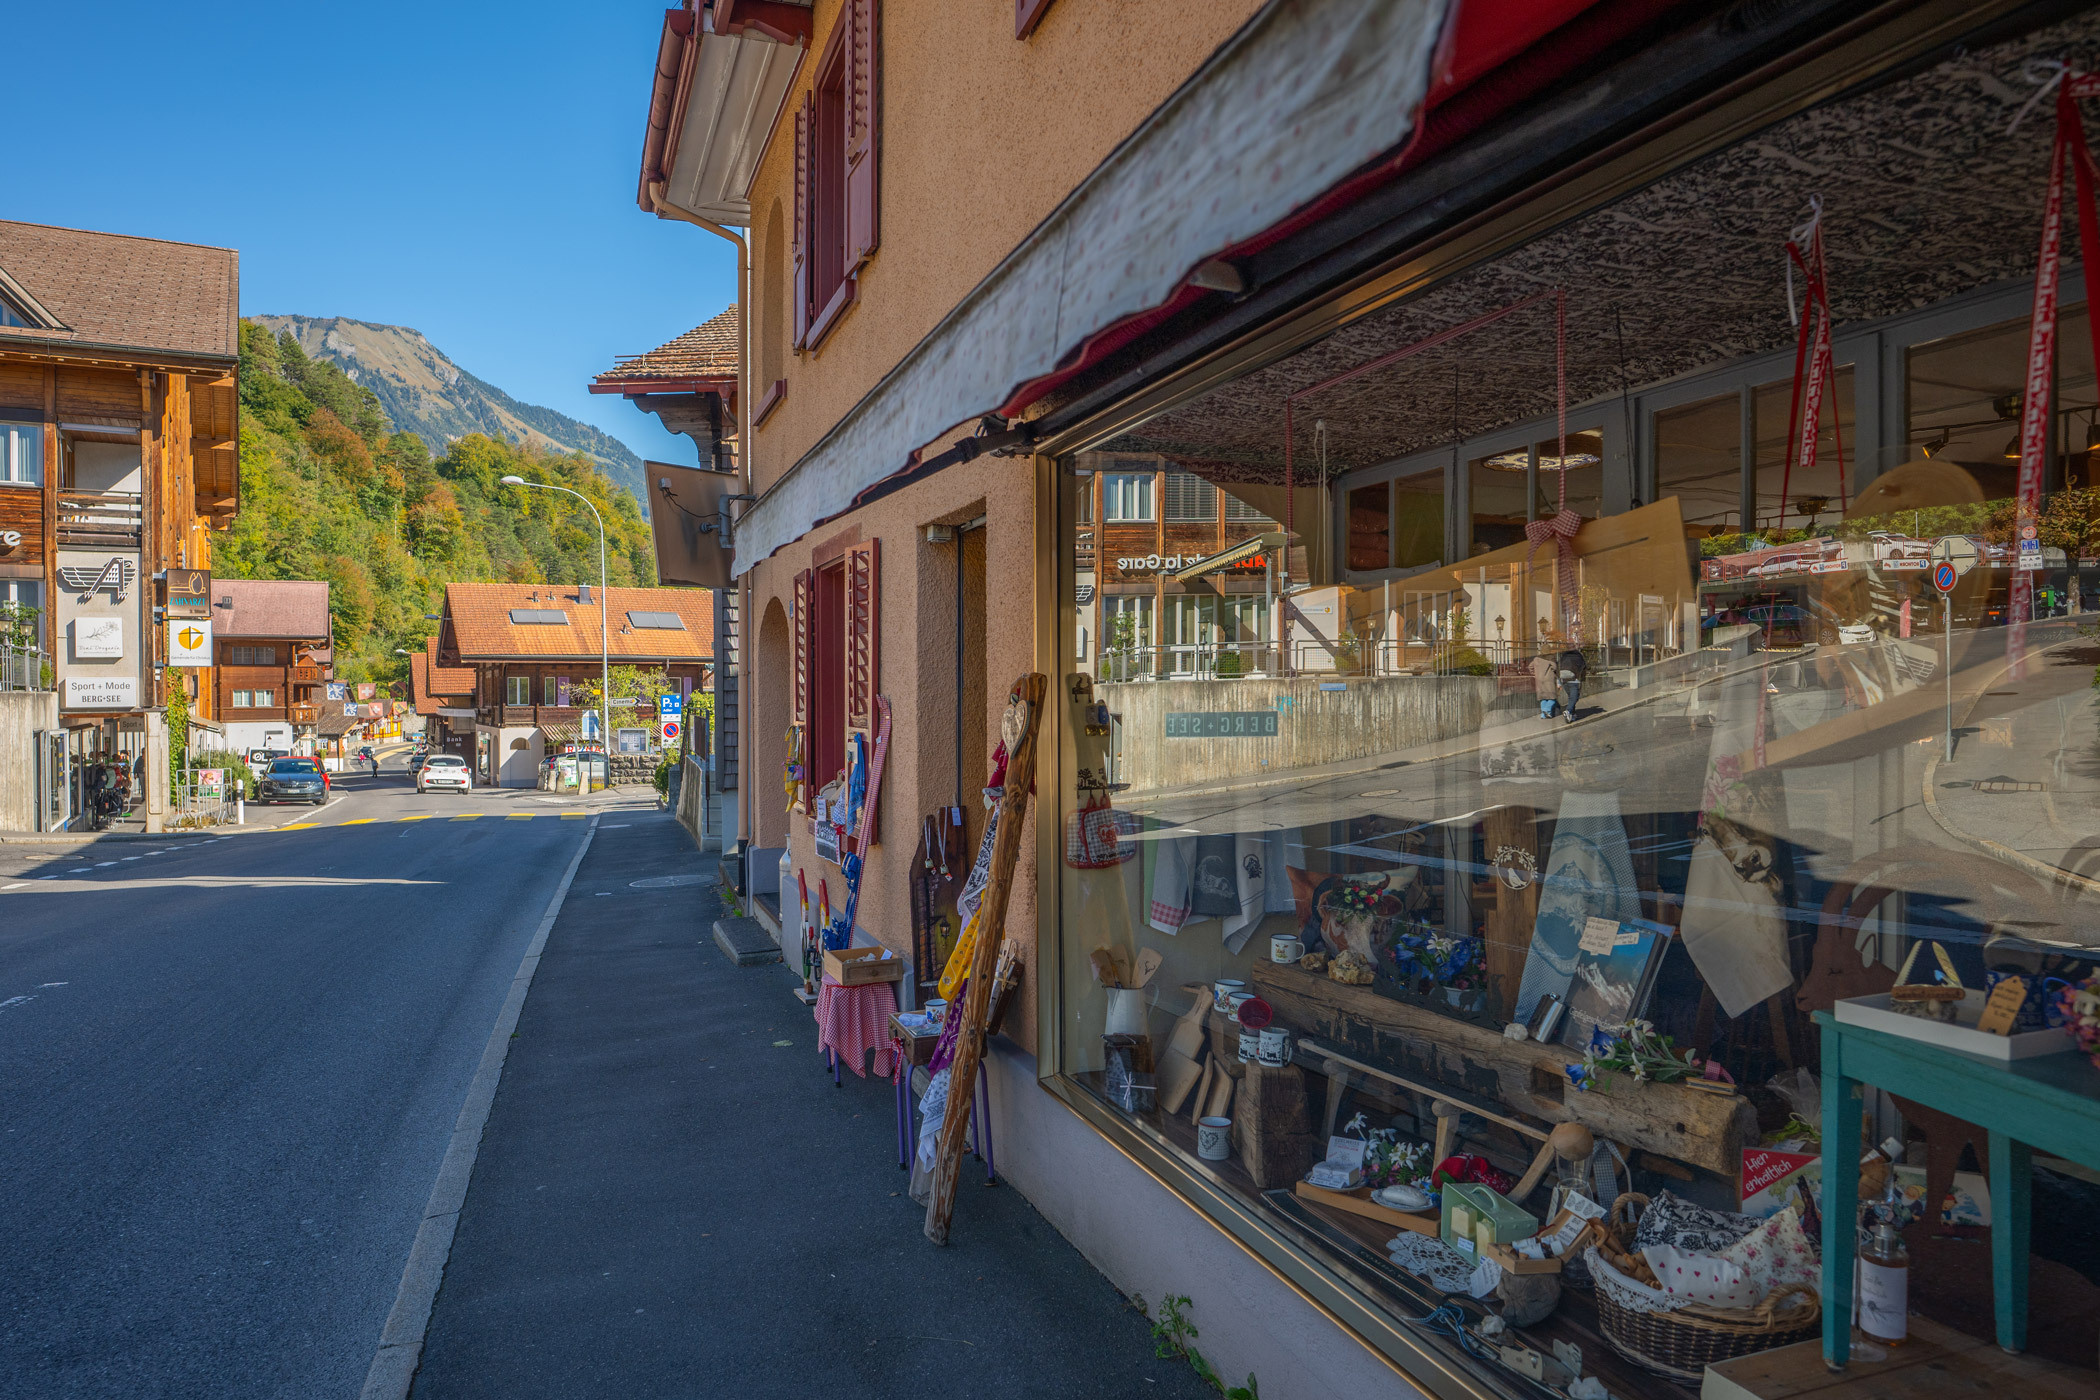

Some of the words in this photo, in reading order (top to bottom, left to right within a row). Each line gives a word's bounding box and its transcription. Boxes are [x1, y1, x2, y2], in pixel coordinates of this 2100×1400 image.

[169, 597, 206, 606] ZAHNARZT
[71, 682, 95, 691] Sport
[105, 682, 131, 690] Mode
[122, 721, 137, 729] Sport
[1745, 1152, 1769, 1172] Hier
[1745, 1159, 1793, 1192] erhältlich
